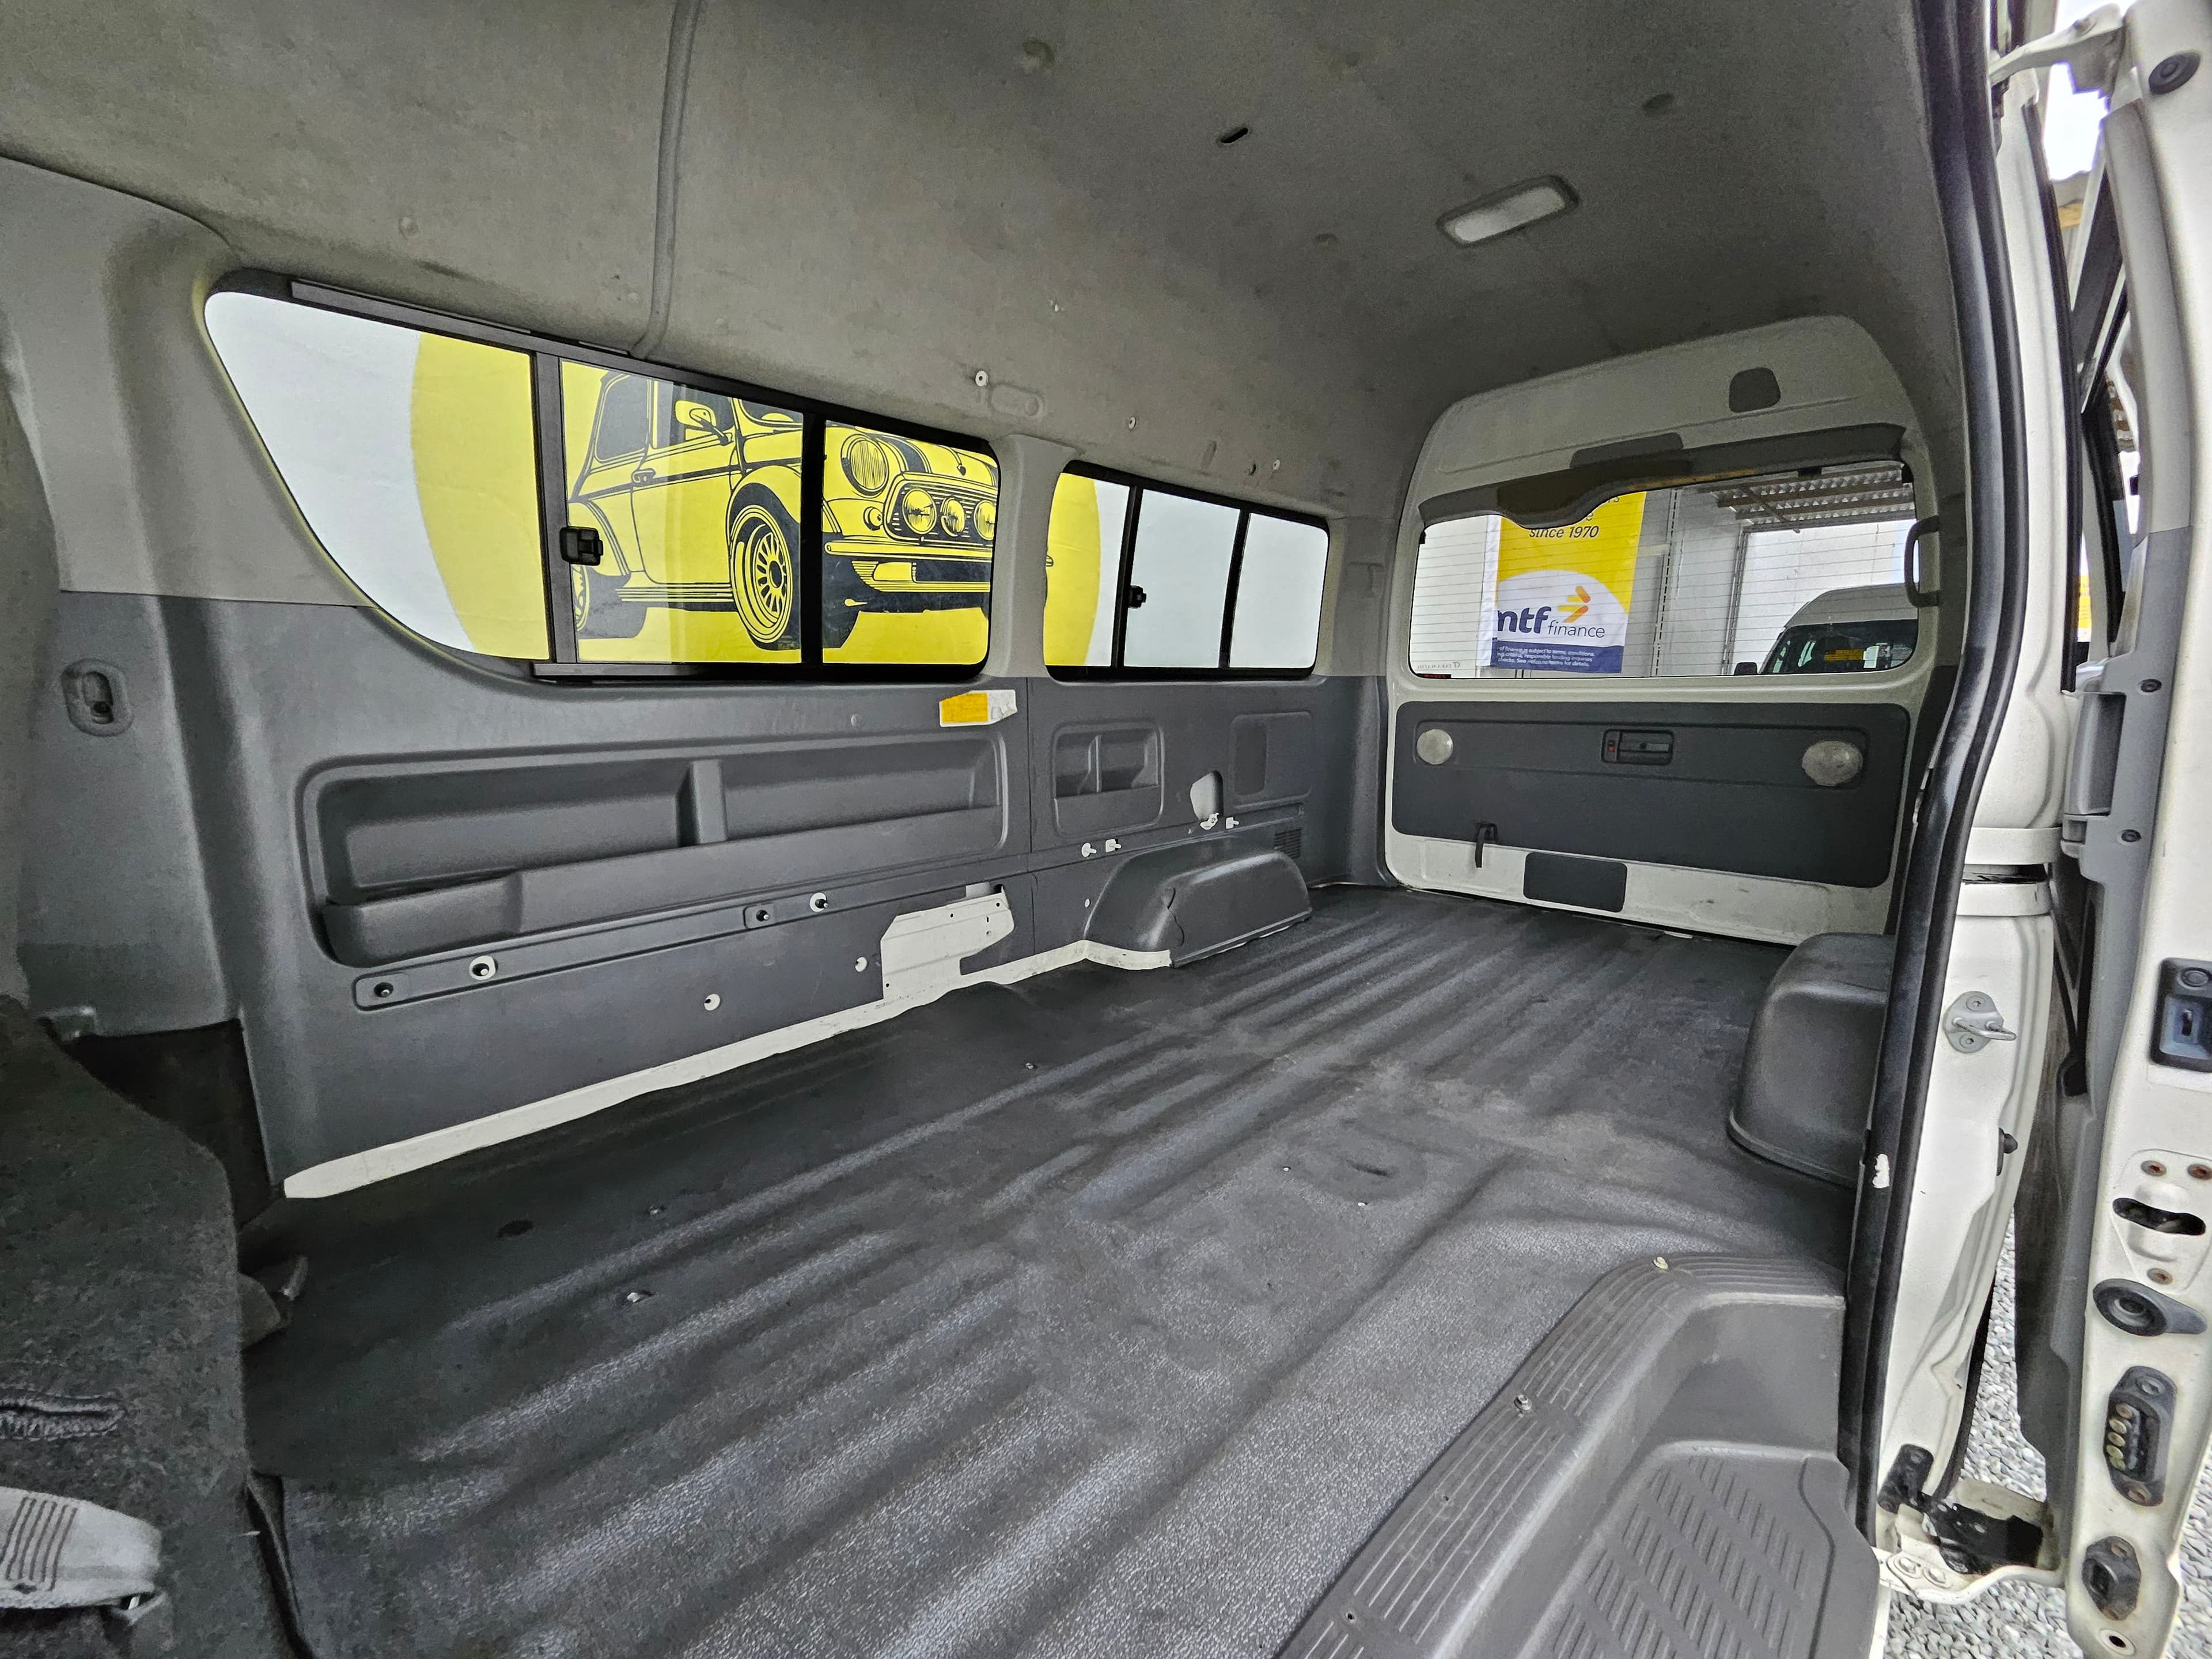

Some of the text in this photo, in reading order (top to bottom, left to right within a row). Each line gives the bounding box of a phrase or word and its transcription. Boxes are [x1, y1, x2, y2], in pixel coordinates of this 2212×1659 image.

[1529, 525, 1600, 538] since 1970
[1548, 620, 1605, 638] finance
